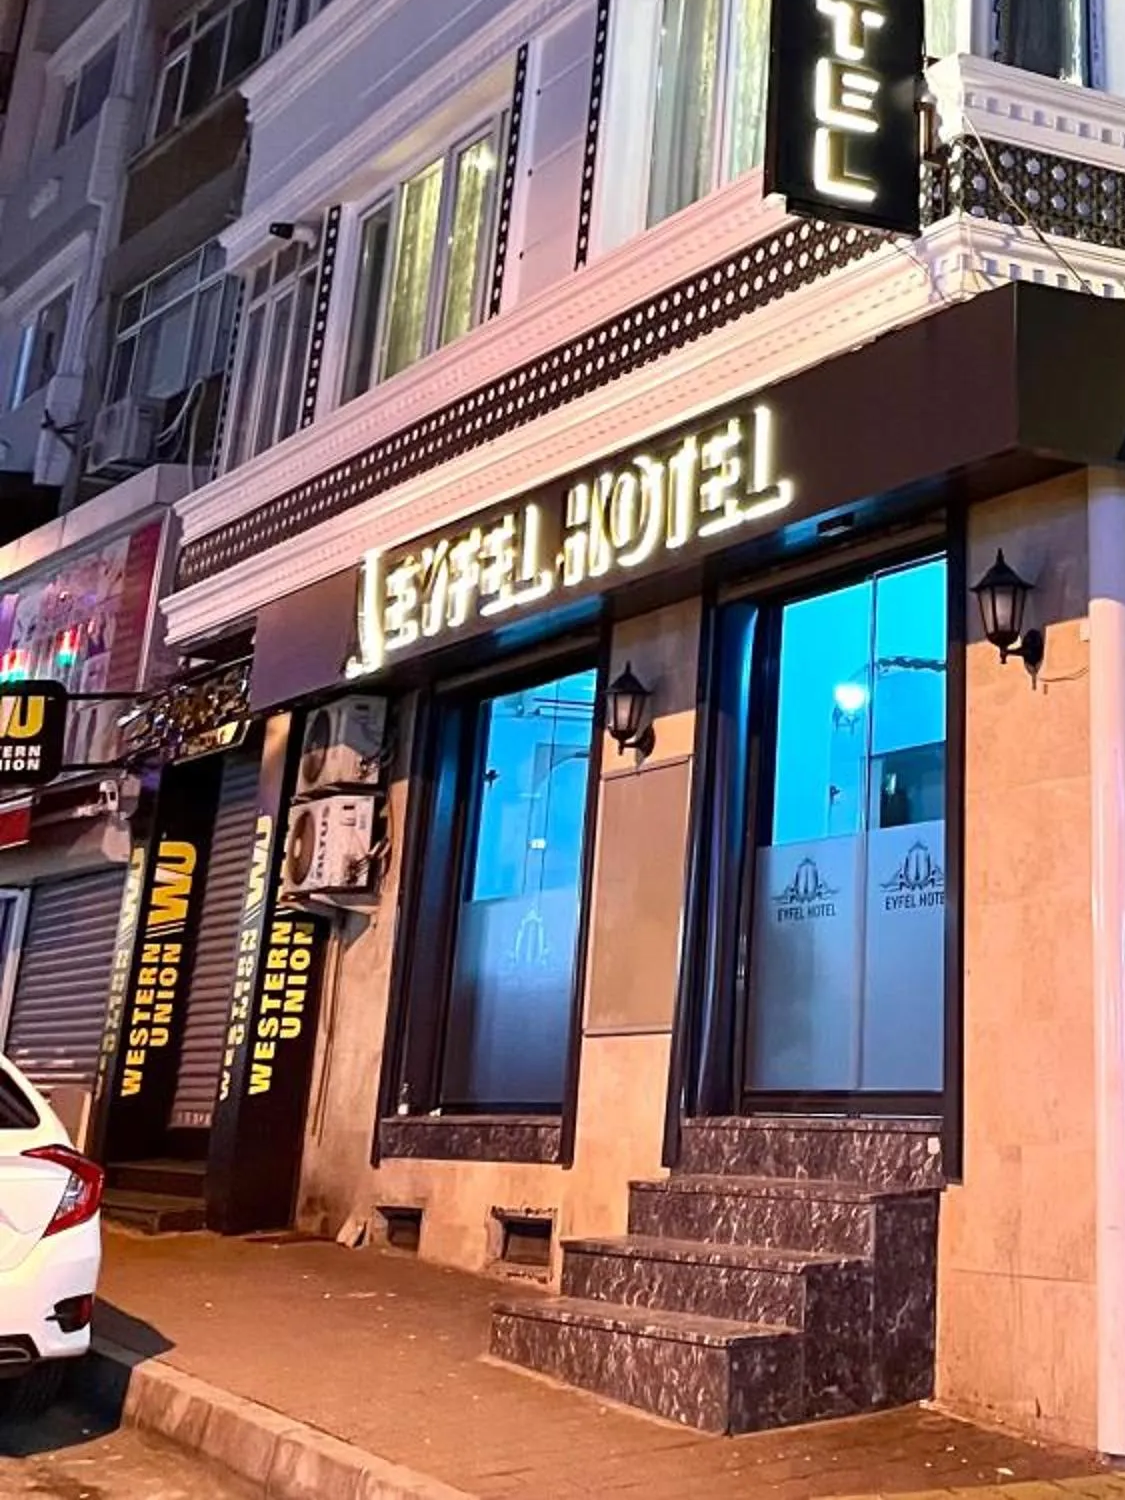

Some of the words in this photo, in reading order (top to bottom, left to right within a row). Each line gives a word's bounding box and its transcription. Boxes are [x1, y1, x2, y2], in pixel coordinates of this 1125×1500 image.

[385, 503, 556, 651] EYFEL
[560, 404, 796, 588] HOTEL
[0, 695, 45, 738] U
[147, 841, 197, 926] WU
[777, 907, 804, 923] EYFEL
[885, 894, 916, 911] EYFEL
[919, 891, 945, 907] HOTE
[120, 943, 162, 1098] WESTERN
[150, 943, 182, 1048] UNION
[249, 921, 293, 1096] WESTERN
[280, 921, 315, 1040] UNION
